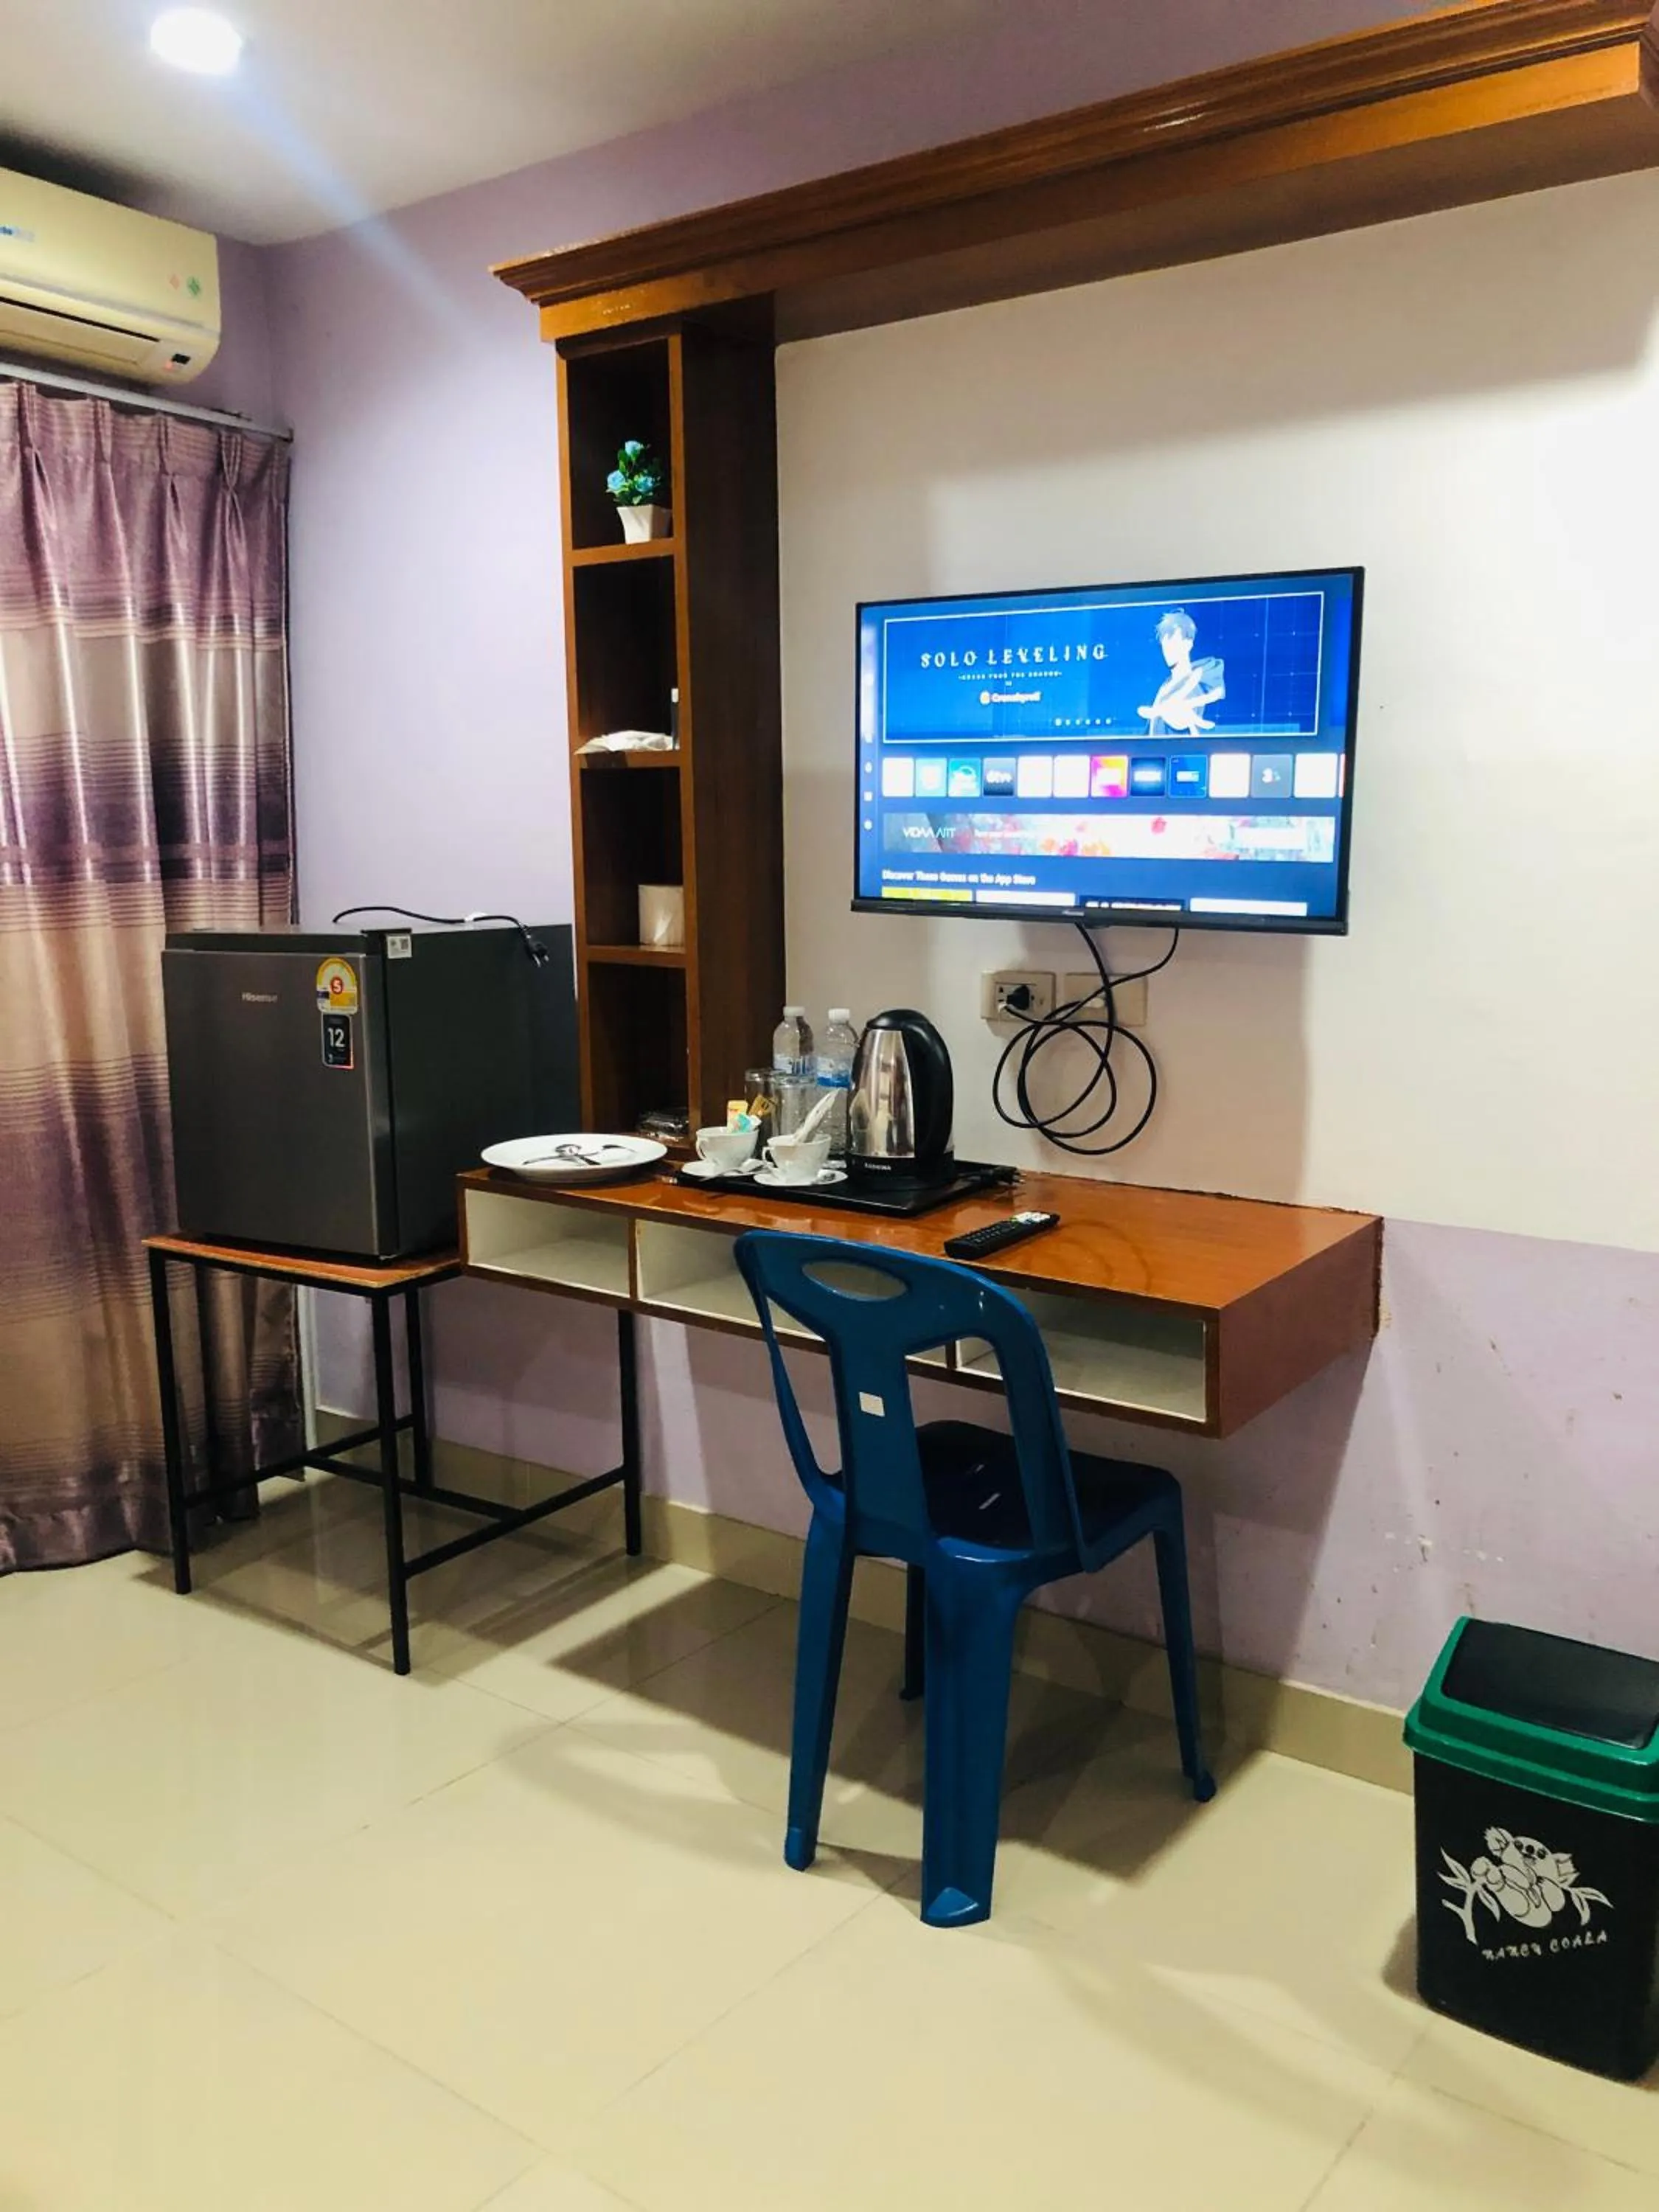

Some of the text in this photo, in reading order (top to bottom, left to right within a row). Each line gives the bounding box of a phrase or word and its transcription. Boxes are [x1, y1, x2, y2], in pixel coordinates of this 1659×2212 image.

[921, 644, 1108, 668] SOLO LEVELING
[327, 1027, 345, 1048] 12
[1549, 1930, 1608, 1953] COALA
